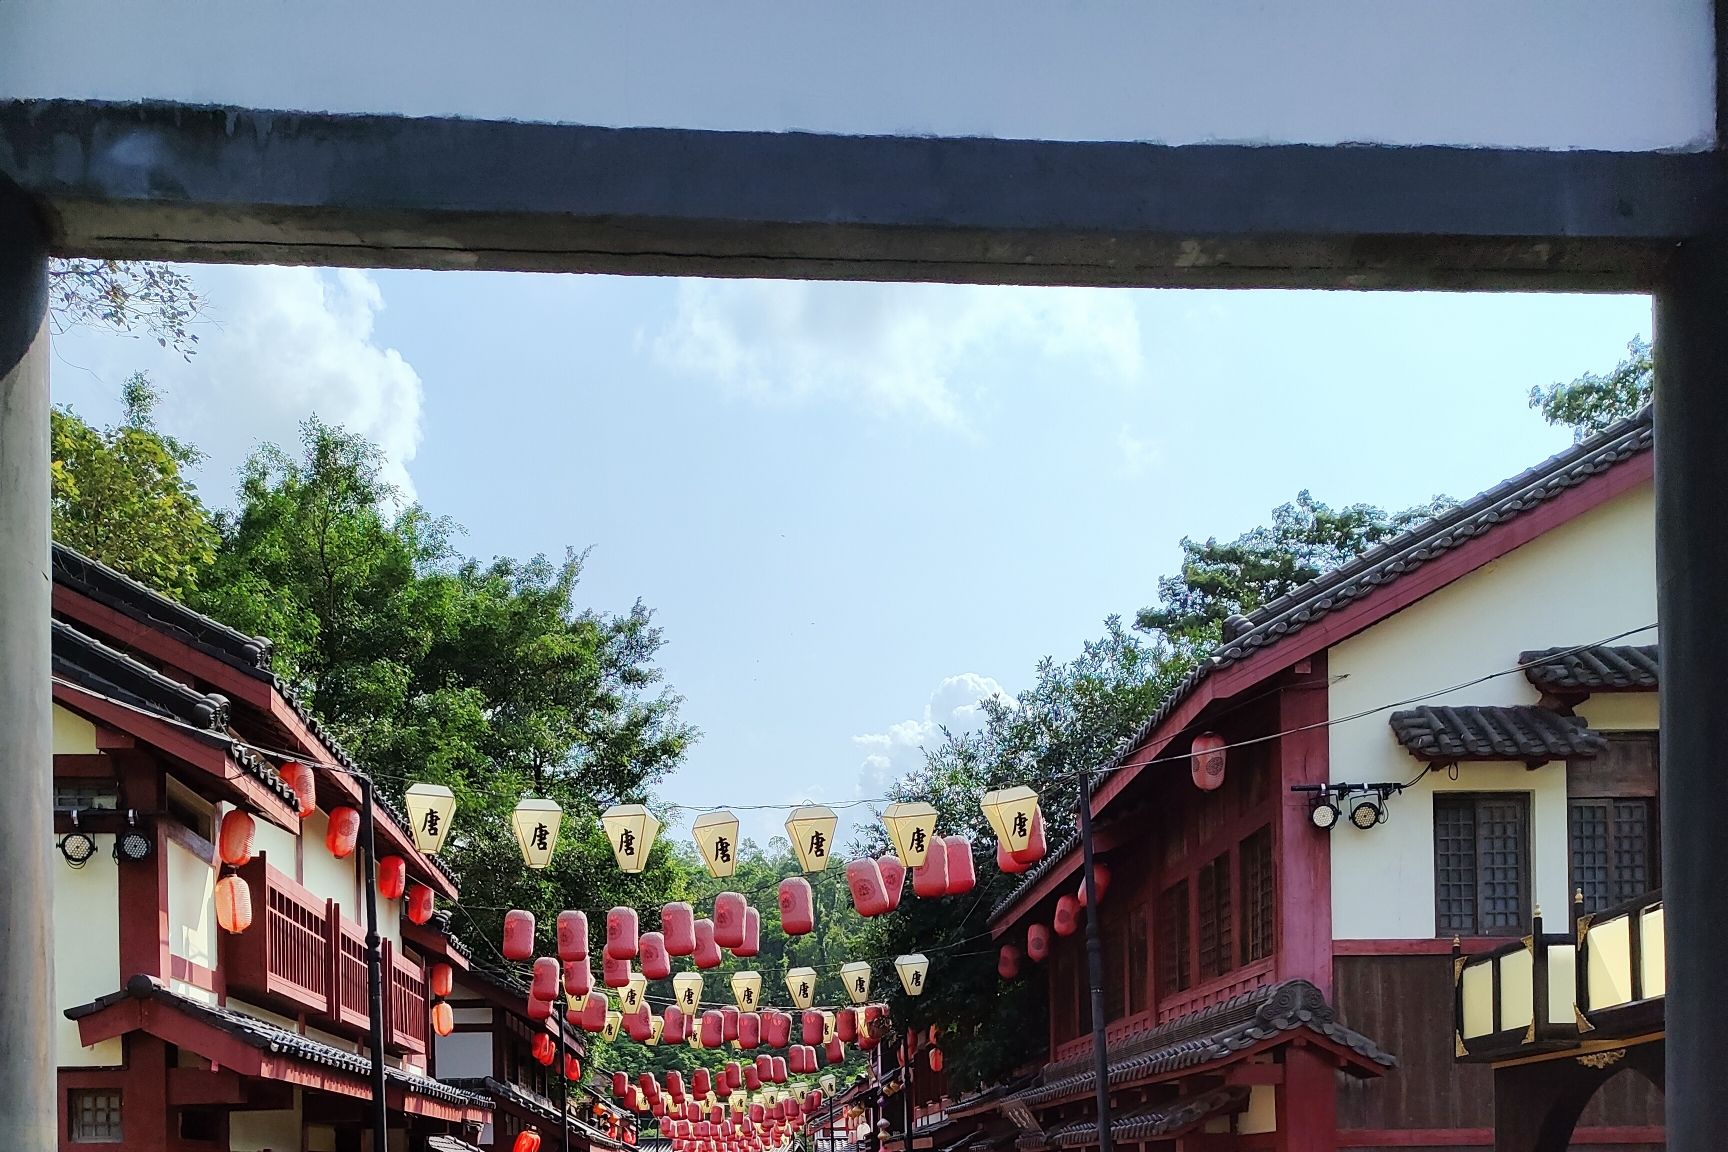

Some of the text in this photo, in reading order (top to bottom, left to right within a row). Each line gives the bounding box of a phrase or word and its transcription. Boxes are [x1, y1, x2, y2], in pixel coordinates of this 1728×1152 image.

[421, 808, 441, 837] 唐
[1012, 811, 1029, 838] 唐
[530, 822, 549, 851] 唐
[618, 828, 636, 857] 唐
[714, 836, 732, 862] 唐
[808, 830, 825, 859] 唐
[909, 827, 927, 852] 唐
[799, 981, 810, 998] 唐
[855, 977, 866, 992] 唐
[911, 970, 922, 986] 唐
[625, 989, 637, 1005] 唐
[682, 987, 695, 1005] 唐
[742, 987, 754, 1005] 唐
